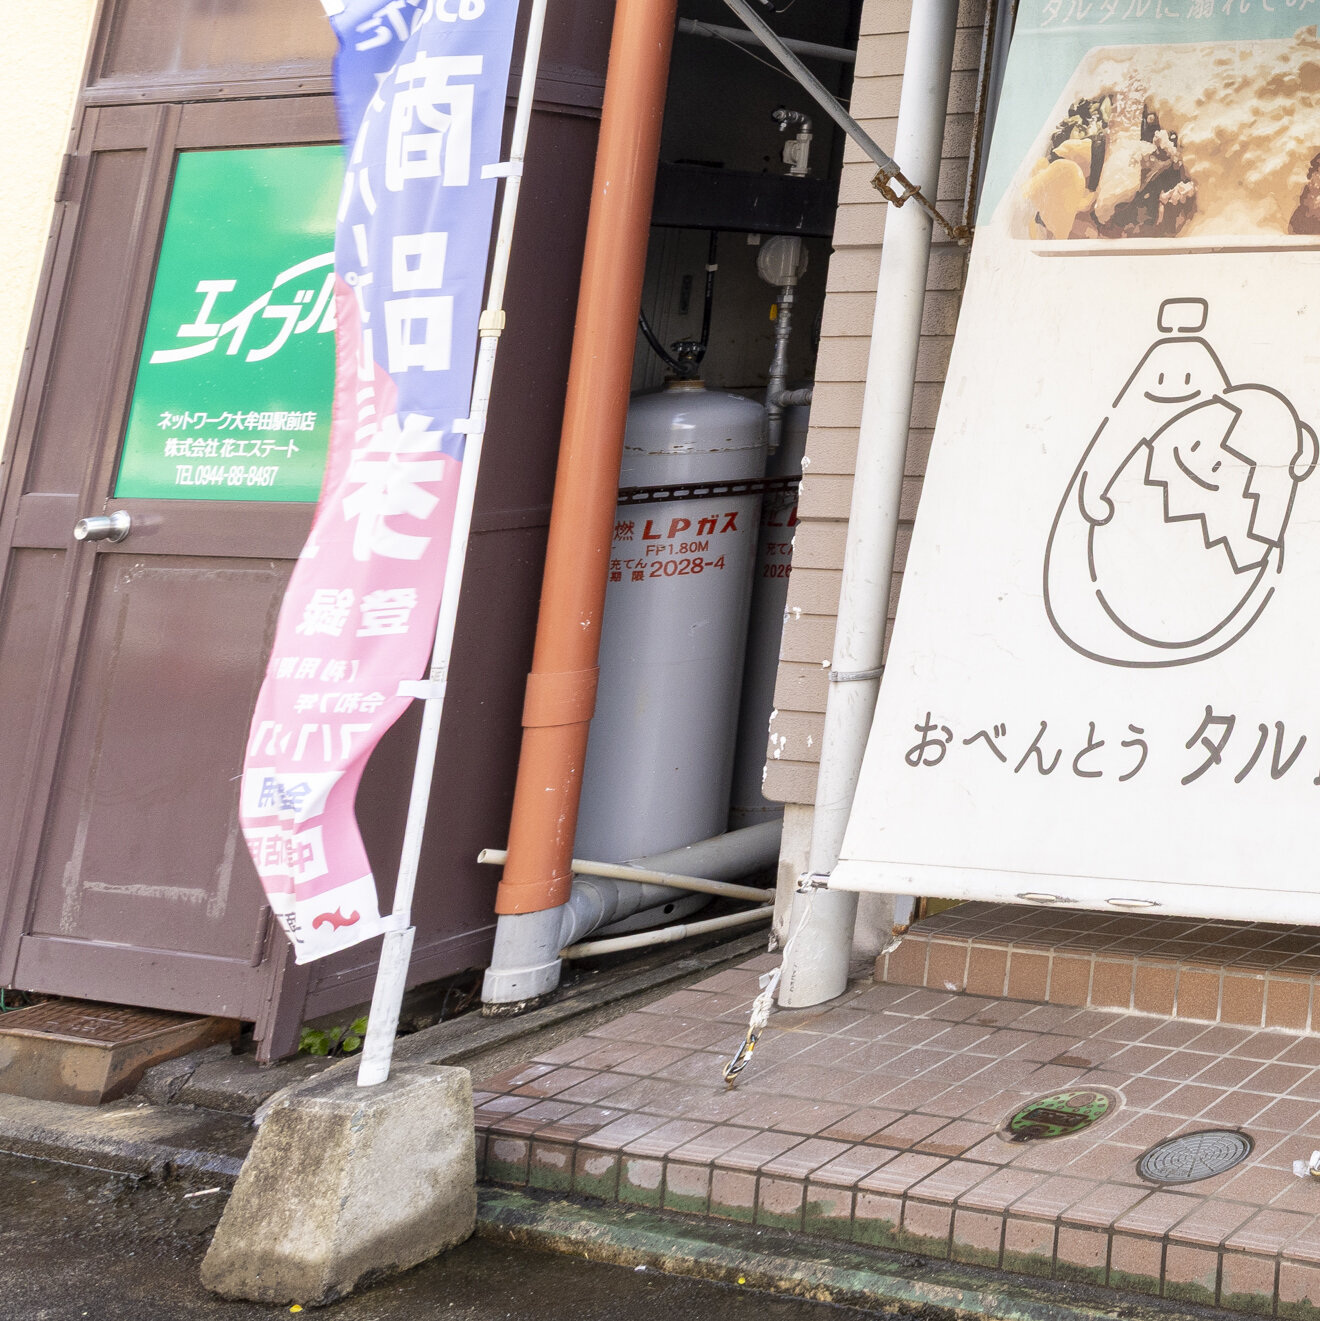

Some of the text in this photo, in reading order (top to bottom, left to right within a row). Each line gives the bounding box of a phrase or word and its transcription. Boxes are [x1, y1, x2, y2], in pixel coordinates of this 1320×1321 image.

[157, 411, 317, 431] ネットワーク大牟田駅前店
[641, 511, 739, 541] LPガス
[649, 554, 726, 578] 2028-4
[904, 711, 1150, 782] おべんとう
